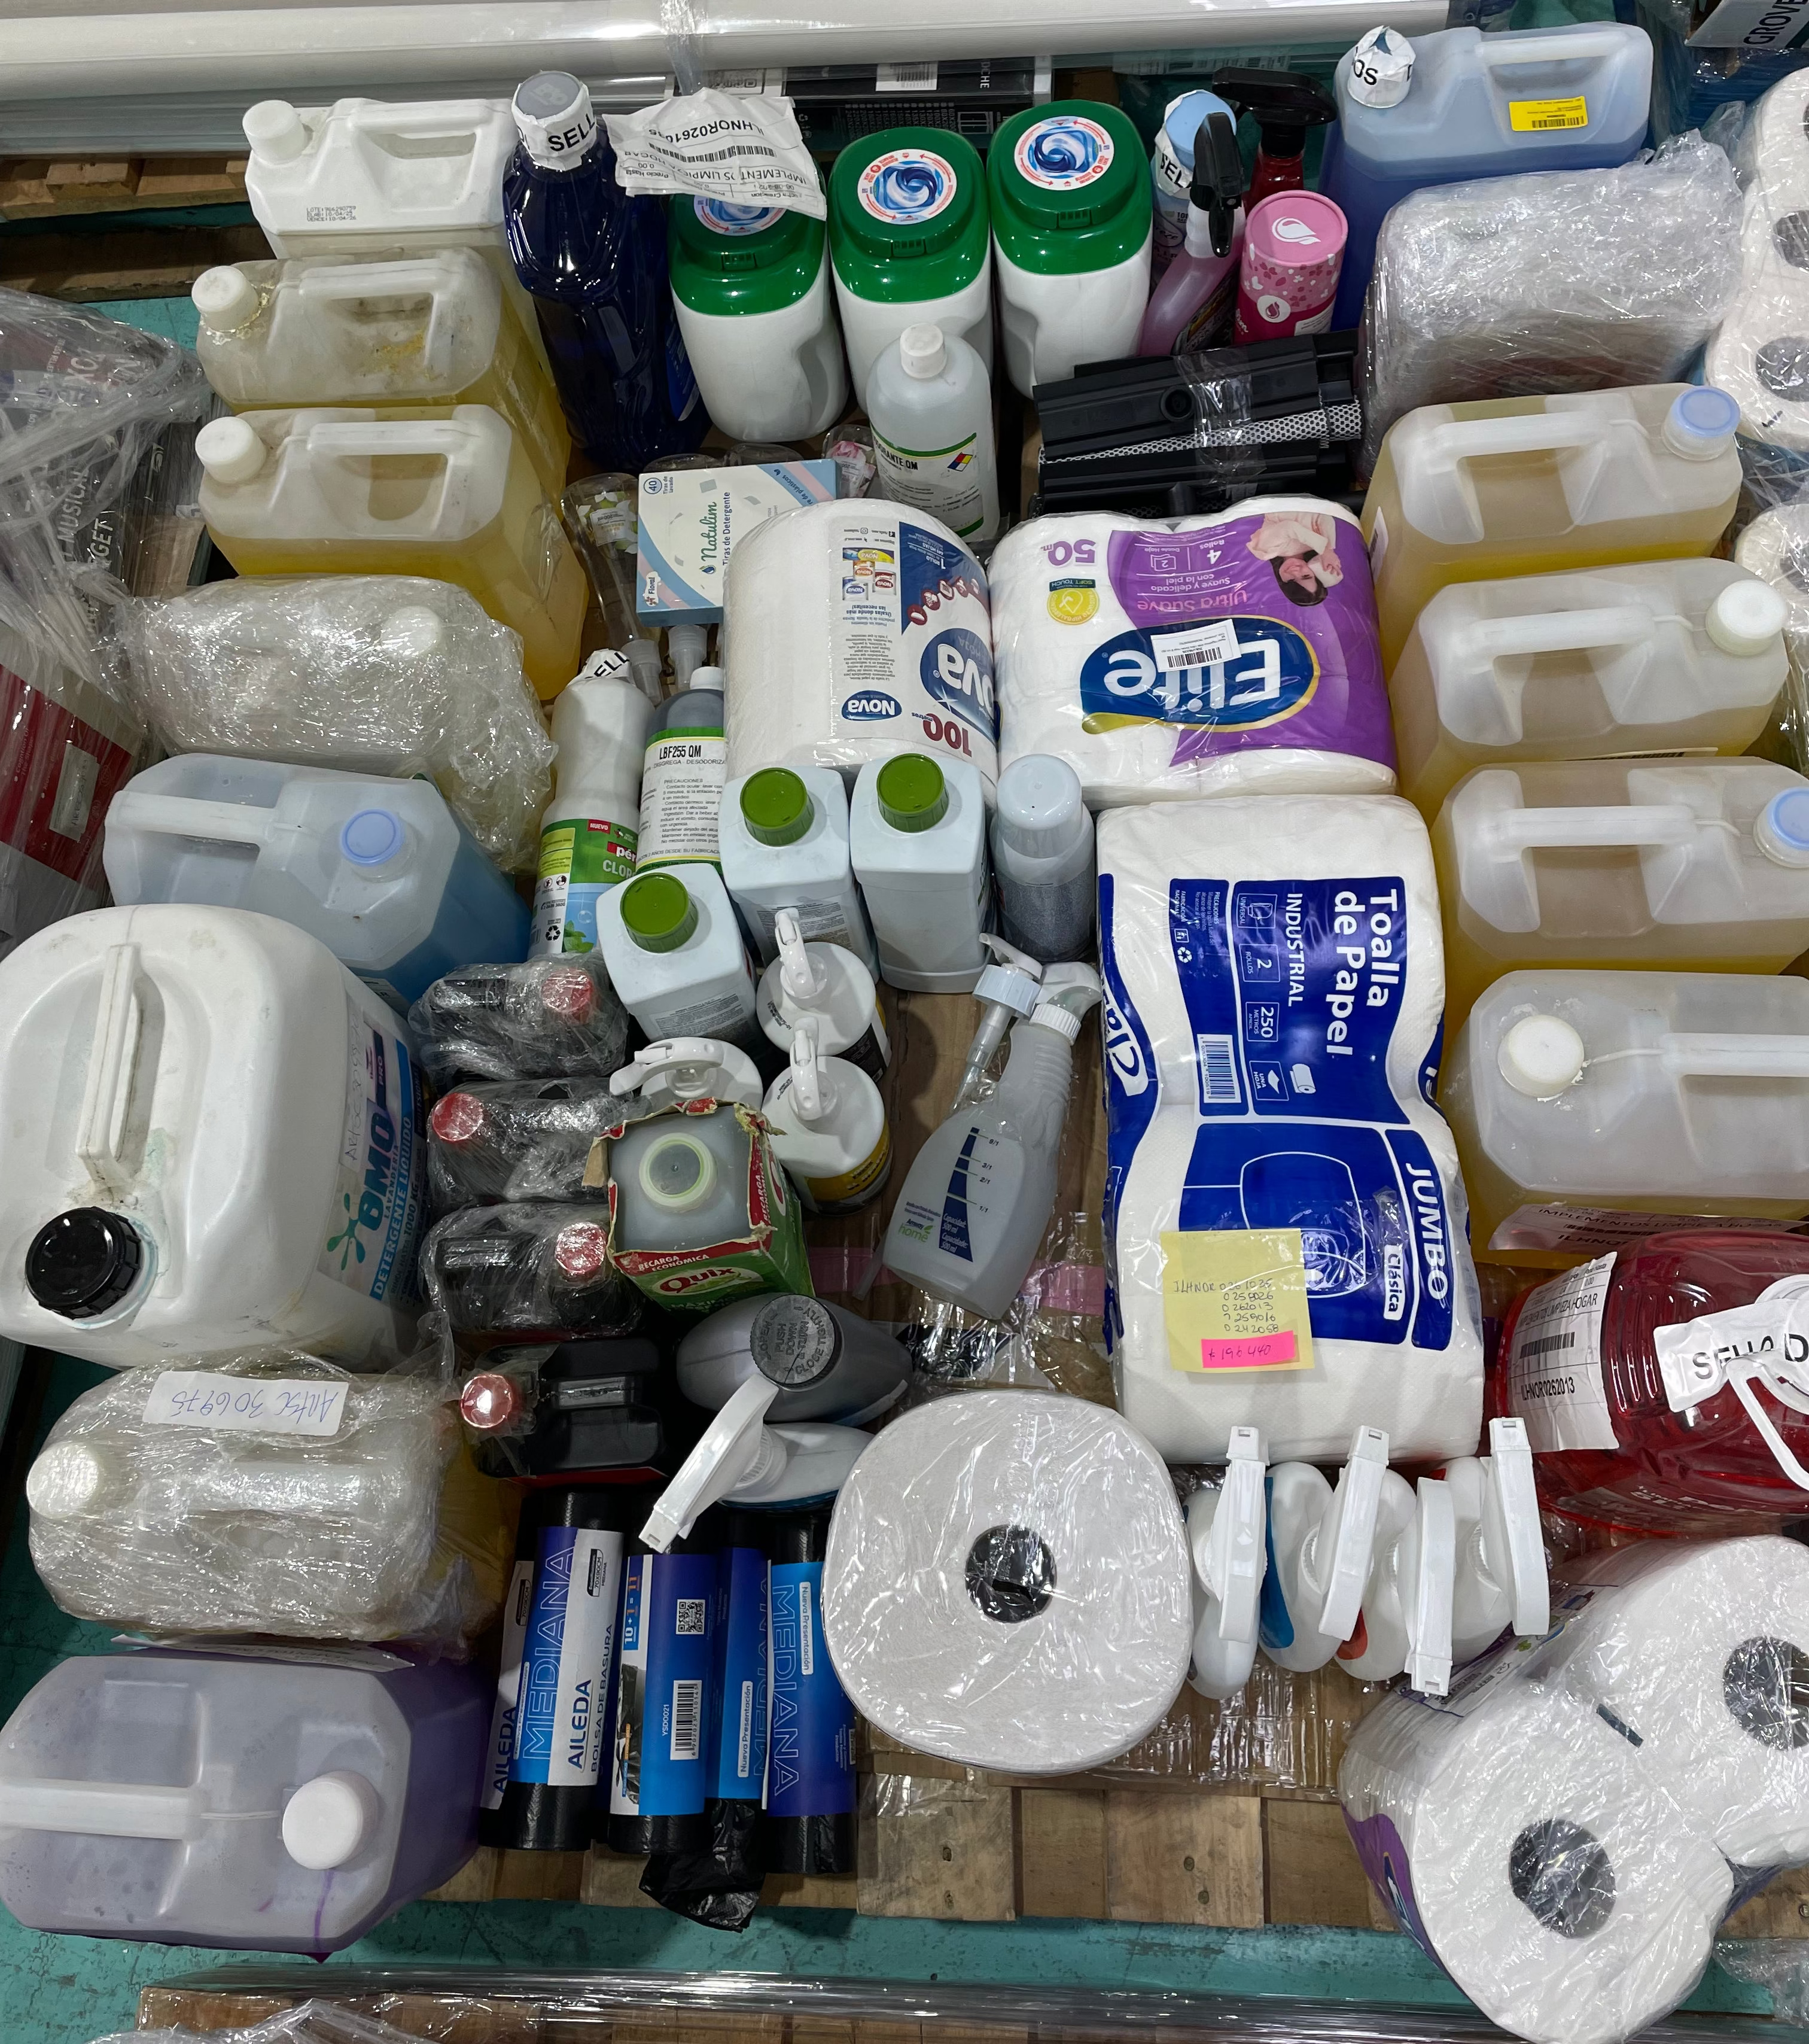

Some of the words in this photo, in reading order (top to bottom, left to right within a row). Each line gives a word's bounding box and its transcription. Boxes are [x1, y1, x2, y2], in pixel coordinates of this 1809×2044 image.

[1160, 152, 1192, 190] SEL
[648, 480, 657, 491] 40
[723, 492, 732, 534] Detergente
[699, 501, 717, 562] Natulim
[724, 536, 731, 546] de
[1199, 540, 1225, 549] Rollos
[723, 549, 731, 565] Tiras
[1047, 539, 1097, 566] 50
[1161, 559, 1170, 568] 2
[1207, 549, 1222, 564] 4
[1050, 579, 1075, 588] TOUCH
[1150, 583, 1192, 592] delicado
[1166, 577, 1185, 586] piel
[1201, 577, 1231, 588] Suave
[1137, 600, 1195, 612] Suave
[1200, 589, 1248, 607] Ultra
[593, 652, 630, 677] ELL
[1103, 638, 1281, 712] Elite
[937, 643, 994, 720] ova
[847, 699, 896, 716] Nova
[912, 712, 933, 722] metros
[922, 712, 973, 758] 100
[659, 745, 686, 760] LBF255
[689, 744, 702, 758] QM
[1334, 890, 1366, 936] de
[1286, 893, 1305, 1007] INDUSTRIAL
[1366, 889, 1399, 1008] Toalla
[1245, 950, 1254, 975] ROLLOS
[1256, 959, 1272, 969] 2
[1326, 945, 1367, 1057] Papel
[1260, 1006, 1275, 1038] 250
[988, 1138, 1000, 1146] 9/1
[358, 1112, 396, 1231] OMO
[982, 1162, 992, 1170] 3/1
[383, 1145, 399, 1219] LAVANDERÍA
[979, 1176, 991, 1185] 2/1
[373, 1184, 406, 1295] DETERGENTE
[398, 1117, 412, 1184] LÍQUIDO
[404, 1204, 416, 1237] 1000
[410, 1182, 418, 1203] KG
[979, 1205, 989, 1213] 1/1
[898, 1222, 929, 1243] home
[1405, 1162, 1449, 1309] JUMBO
[638, 1255, 680, 1272] RECARGA
[659, 1268, 735, 1294] Quix
[1385, 1253, 1404, 1313] Clásica
[1572, 1293, 1598, 1311] HOGAR
[775, 1323, 787, 1352] PUSH
[624, 1626, 634, 1644] 10
[523, 1545, 575, 1760] MEDIANA
[600, 1623, 613, 1694] BASURA
[772, 1584, 800, 1797] MEDIANA
[597, 1694, 605, 1714] DE
[741, 1684, 751, 1742] Presentación
[568, 1678, 592, 1770] AILEDA
[662, 1704, 670, 1736] YSD0021
[492, 1706, 517, 1794] AILEDA
[591, 1719, 604, 1773] BOLSA
